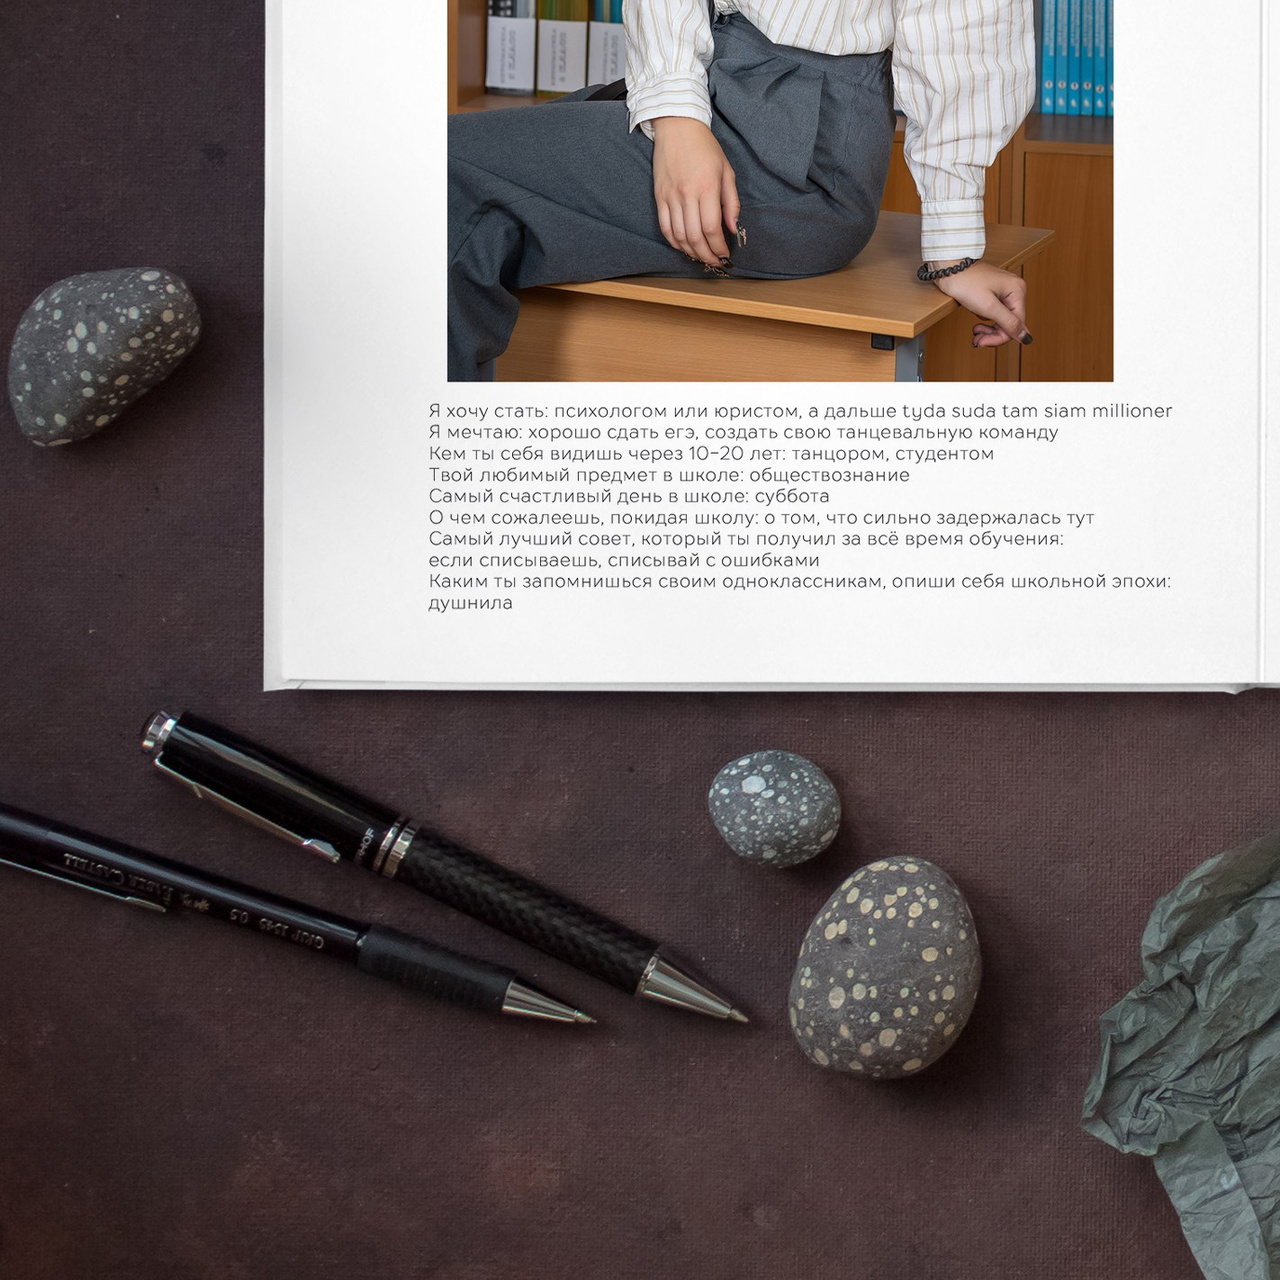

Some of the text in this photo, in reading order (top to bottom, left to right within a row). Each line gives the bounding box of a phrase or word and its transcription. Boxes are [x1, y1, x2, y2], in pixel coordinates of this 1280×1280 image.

[428, 402, 1173, 422] Я хочу стать: психологом или юристом, а дальше tyda suda tam siam millioner
[428, 423, 1059, 443] Я мечтаю: хорошо сдать егэ, создать свою танцевальную команду
[429, 445, 466, 461] Кем
[471, 449, 494, 461] ты
[500, 445, 544, 461] себя
[550, 449, 623, 463] видишь
[628, 448, 684, 464] через
[749, 448, 786, 461] лет:
[791, 448, 890, 464] танцором,
[895, 448, 994, 465] студентом
[428, 466, 910, 486] Твой любимый предмет в школе: обществознание
[428, 487, 830, 507] Самый счастливый день в школе: суббота
[429, 509, 1095, 529] О чем сожалеешь, покидая школу: о том, что сильно задержалась тут
[429, 530, 1064, 550] Самый лучший совет, который ты получил за всё время обучения:
[428, 551, 820, 569] если списываешь, списывай с ошибками
[429, 572, 1171, 591] Каким ты запомнишься своим одноклассникам, опиши себя школьной эпохи:
[427, 597, 513, 614] душнила
